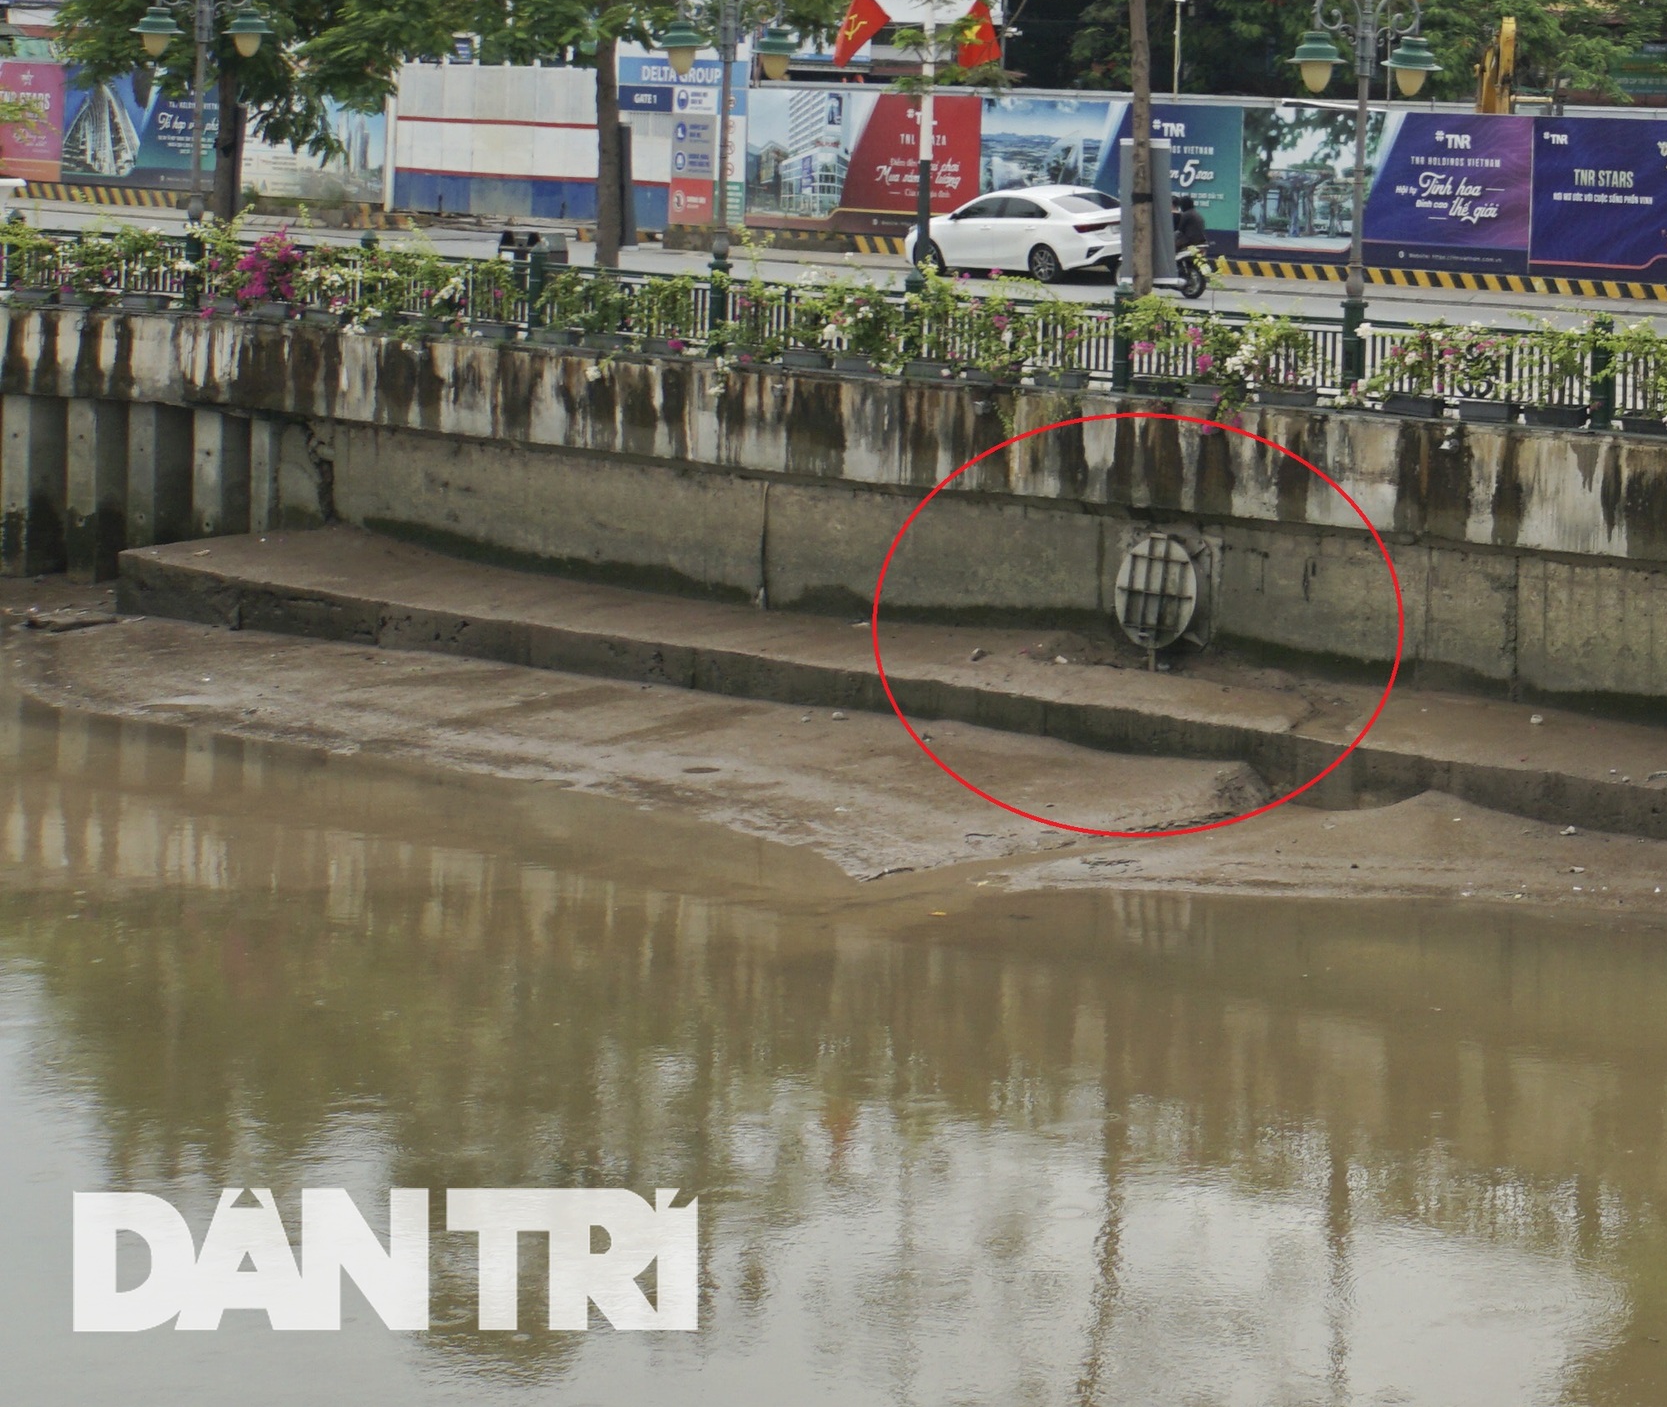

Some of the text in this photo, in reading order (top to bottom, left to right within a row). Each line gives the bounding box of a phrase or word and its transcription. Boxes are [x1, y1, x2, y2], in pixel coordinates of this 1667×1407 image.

[641, 65, 677, 82] DELTA
[634, 94, 657, 104] GATE 1
[1162, 122, 1186, 138] TNR
[1445, 134, 1472, 149] TNR
[1550, 134, 1569, 145] TNR
[1179, 159, 1200, 188] 5
[1573, 168, 1635, 189] TNR STARS
[1455, 176, 1482, 197] hoa
